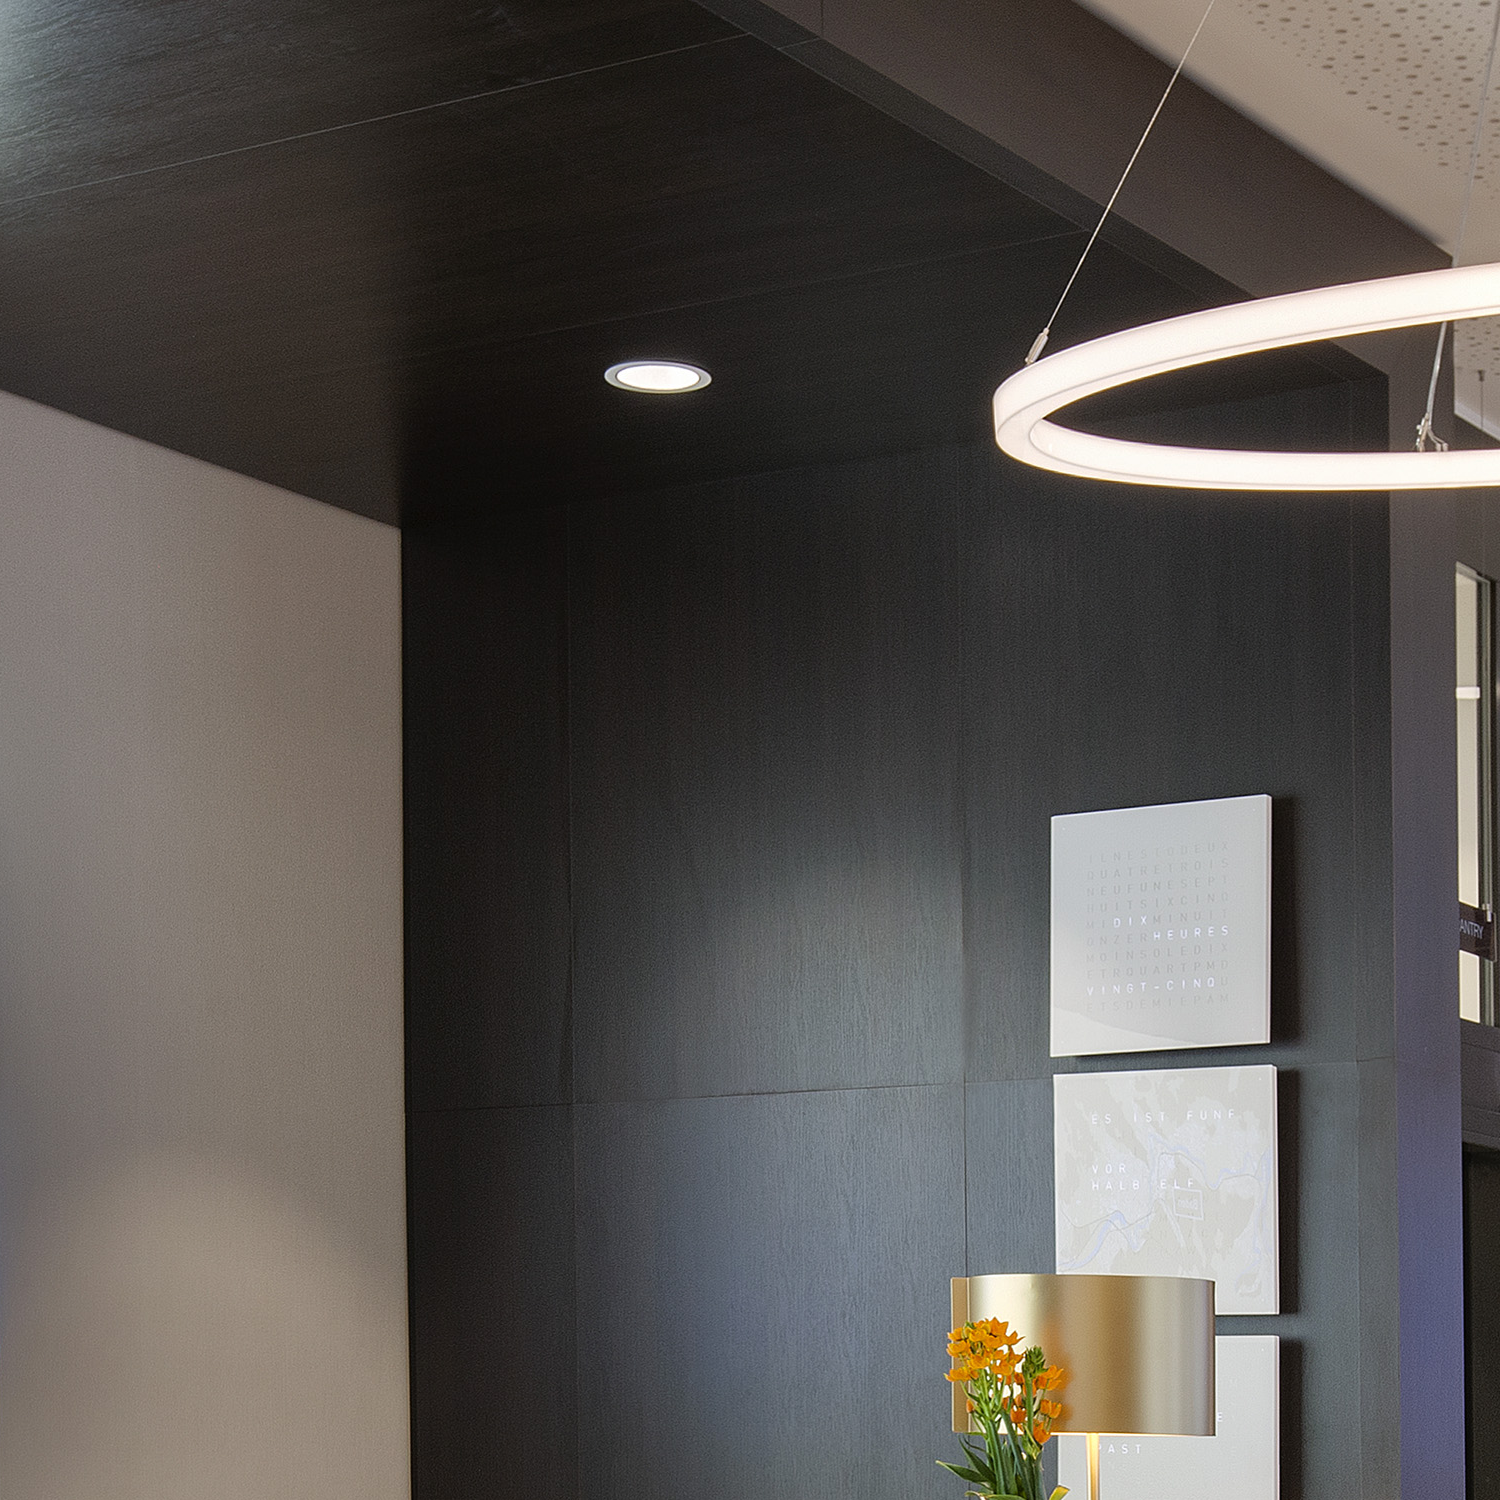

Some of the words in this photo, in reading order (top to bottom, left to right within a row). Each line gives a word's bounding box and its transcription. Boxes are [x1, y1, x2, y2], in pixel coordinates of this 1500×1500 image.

[1460, 918, 1484, 939] ANTRY
[1091, 1113, 1112, 1125] ES
[1133, 1111, 1166, 1123] IST
[1091, 1163, 1127, 1175] VOR
[1091, 1180, 1140, 1191] HALB
[1160, 1179, 1194, 1190] ELF
